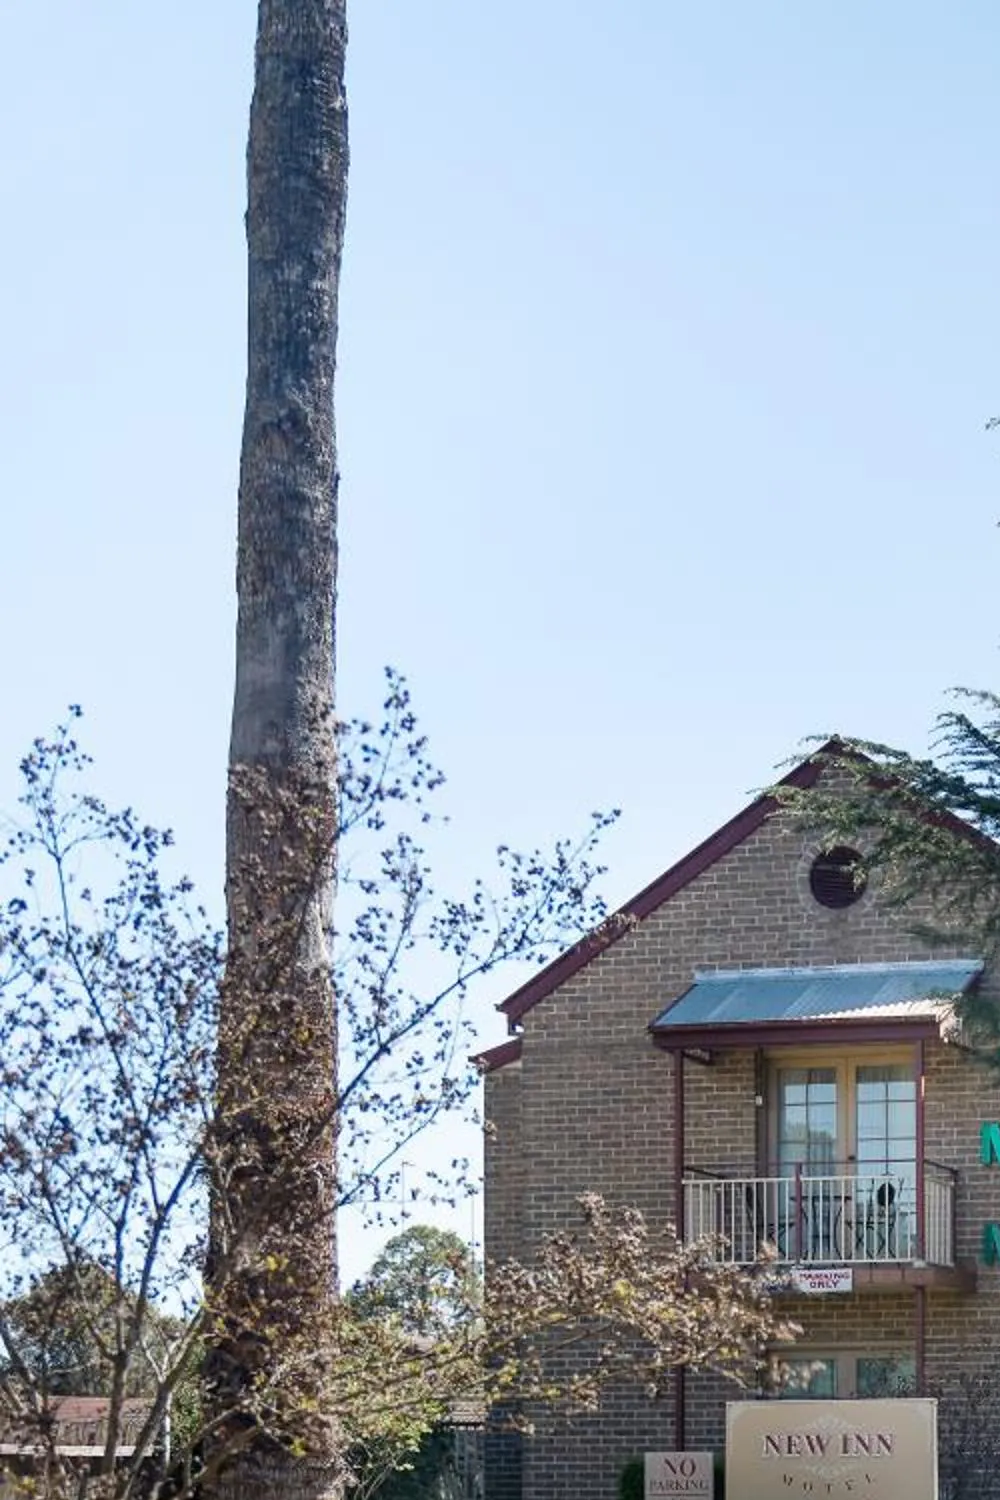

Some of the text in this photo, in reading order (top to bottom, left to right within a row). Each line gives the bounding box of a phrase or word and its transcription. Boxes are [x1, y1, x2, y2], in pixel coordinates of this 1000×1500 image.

[809, 1280, 840, 1289] ONLY
[762, 1433, 895, 1457] NEW INN
[664, 1458, 697, 1478] NO
[649, 1479, 710, 1492] PARKING
